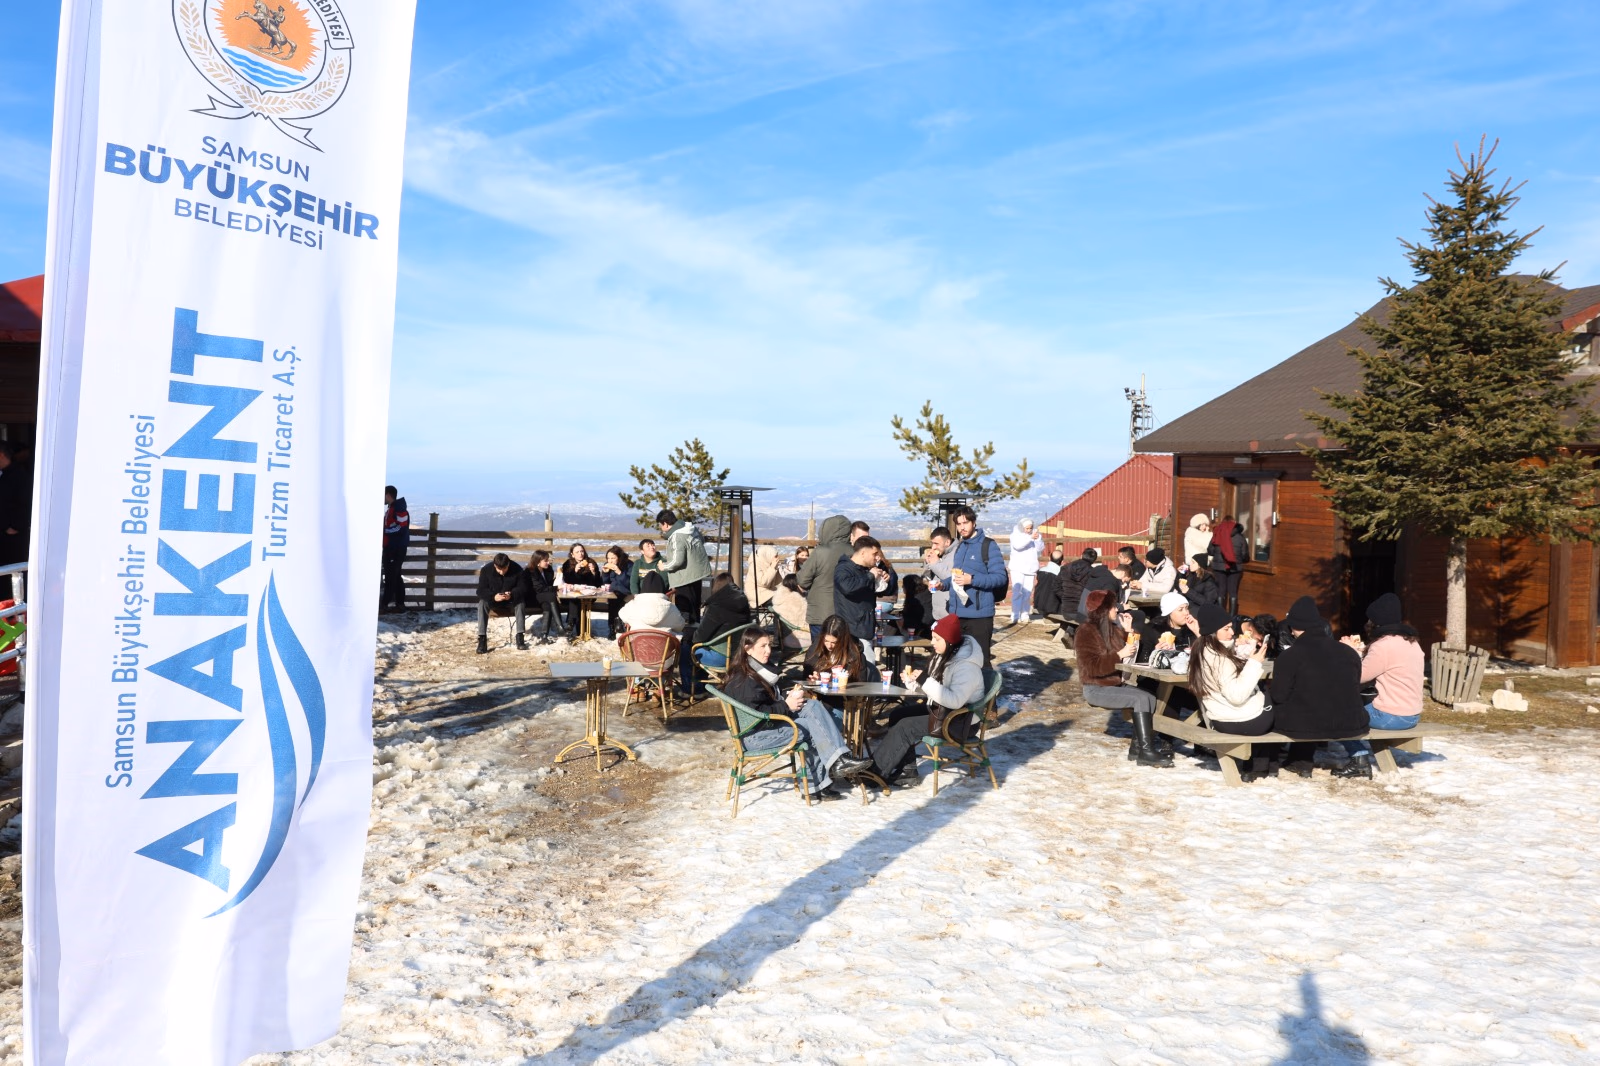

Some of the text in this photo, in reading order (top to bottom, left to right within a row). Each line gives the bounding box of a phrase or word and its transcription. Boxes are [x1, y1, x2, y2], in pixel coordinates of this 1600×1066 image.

[104, 142, 380, 240] BÜYÜKŞEHİR
[174, 197, 323, 251] BELEDİYESİ
[201, 135, 310, 183] SAMSUN
[261, 345, 302, 562] Turizm Ticaret A.Ş.
[105, 414, 161, 789] Samsun Büyükşehir Belediyesi
[133, 306, 265, 893] ANAKENT
